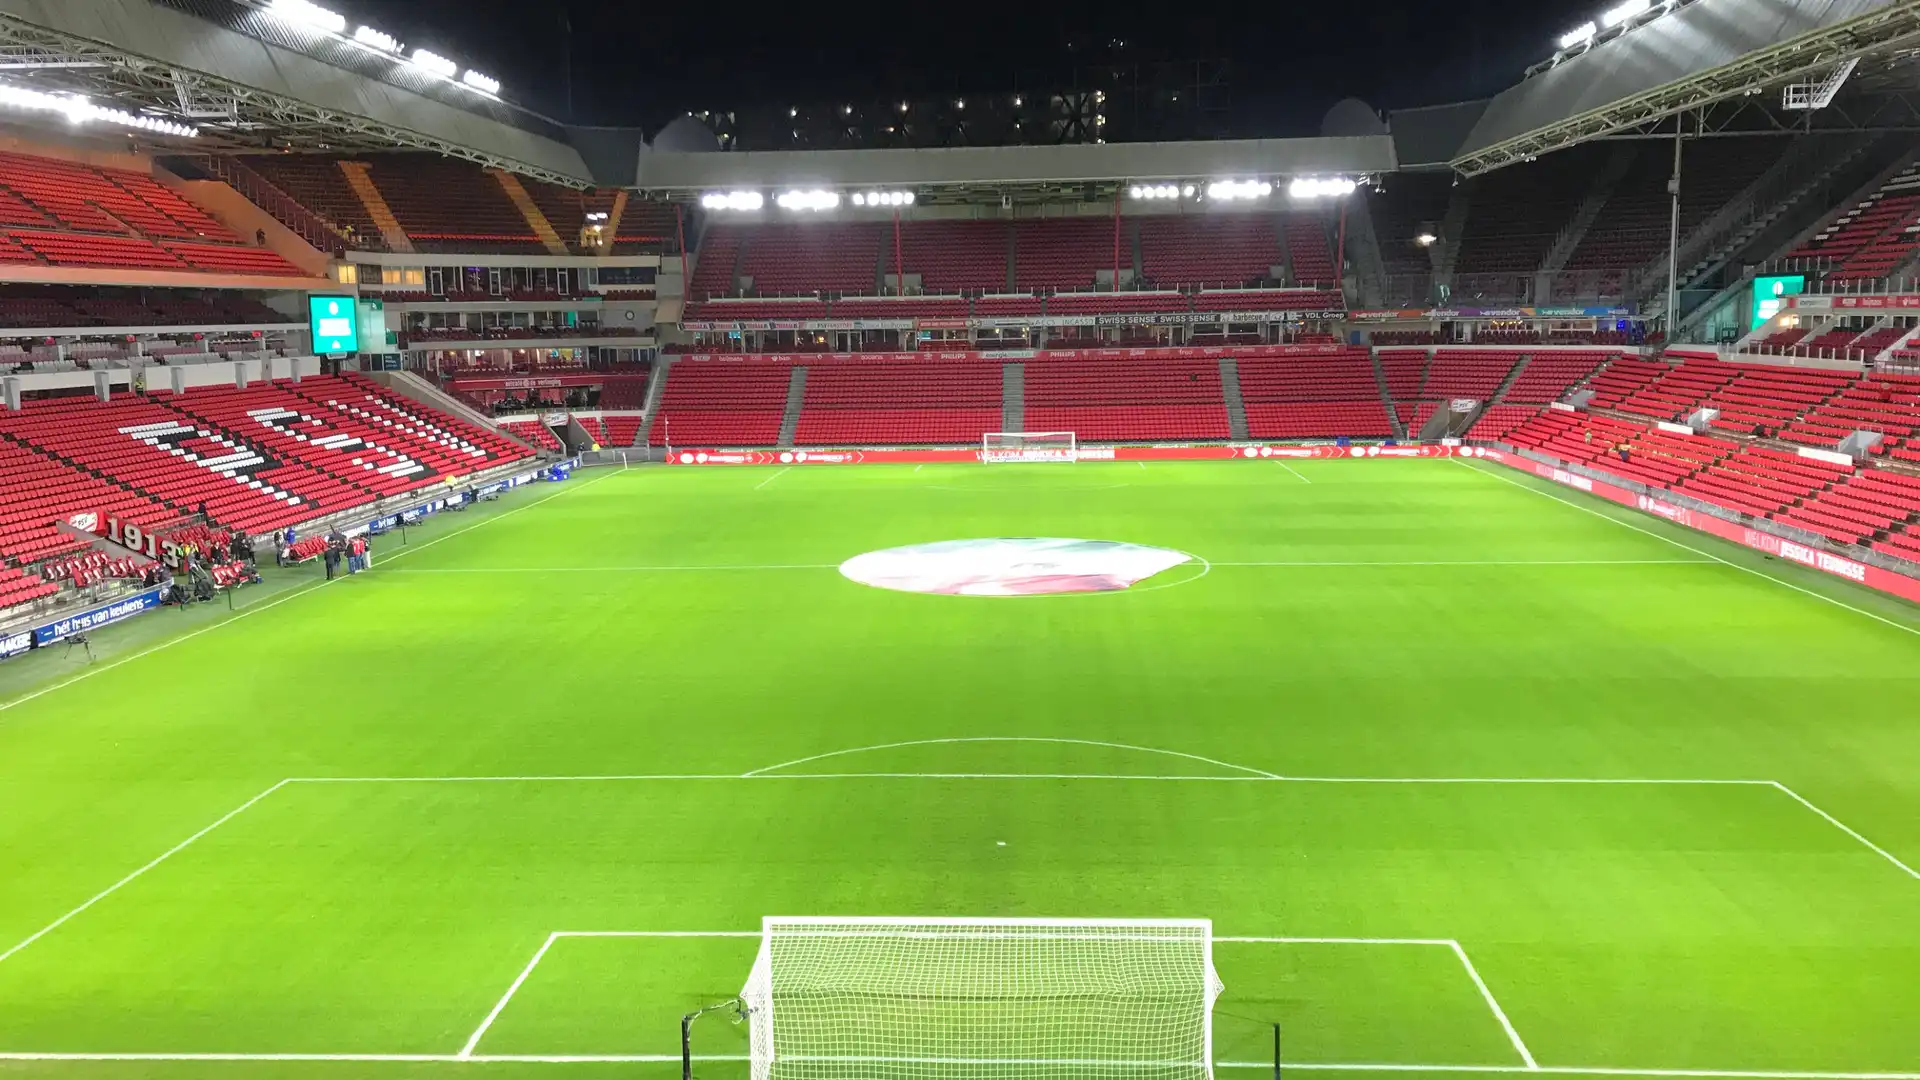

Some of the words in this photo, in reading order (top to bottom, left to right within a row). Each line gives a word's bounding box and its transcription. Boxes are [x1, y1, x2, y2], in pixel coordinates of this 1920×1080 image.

[1323, 312, 1345, 320] Groep
[107, 517, 181, 568] 1913
[1745, 528, 1779, 554] WELKOM
[54, 620, 70, 637] hét
[92, 610, 109, 624] van
[109, 598, 144, 619] keukens
